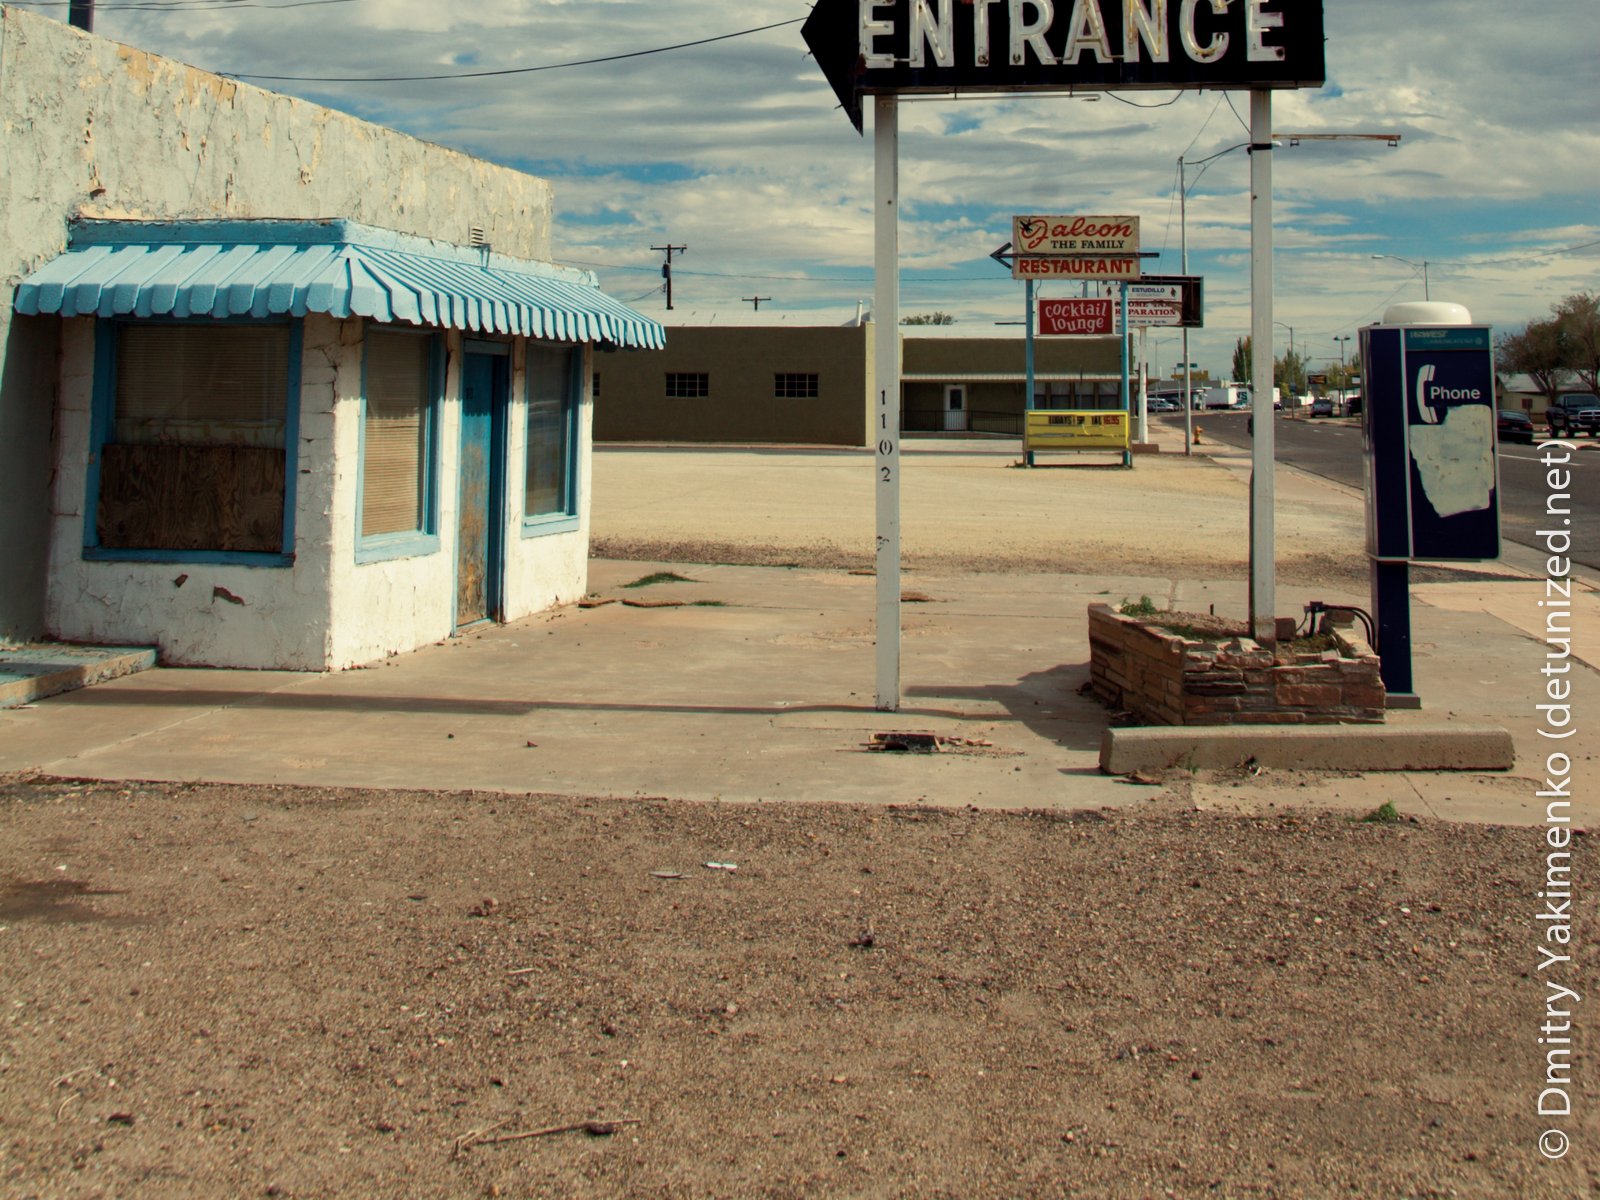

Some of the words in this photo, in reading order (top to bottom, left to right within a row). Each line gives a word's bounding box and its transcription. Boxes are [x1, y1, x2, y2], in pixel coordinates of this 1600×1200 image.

[1020, 217, 1133, 249] Falcon
[1051, 240, 1077, 249] THE
[1081, 240, 1125, 249] FAMILY
[1019, 259, 1133, 274] RESTAURANT
[1045, 302, 1107, 318] cocktail
[1052, 317, 1104, 333] lounge
[1430, 386, 1481, 400] Phone
